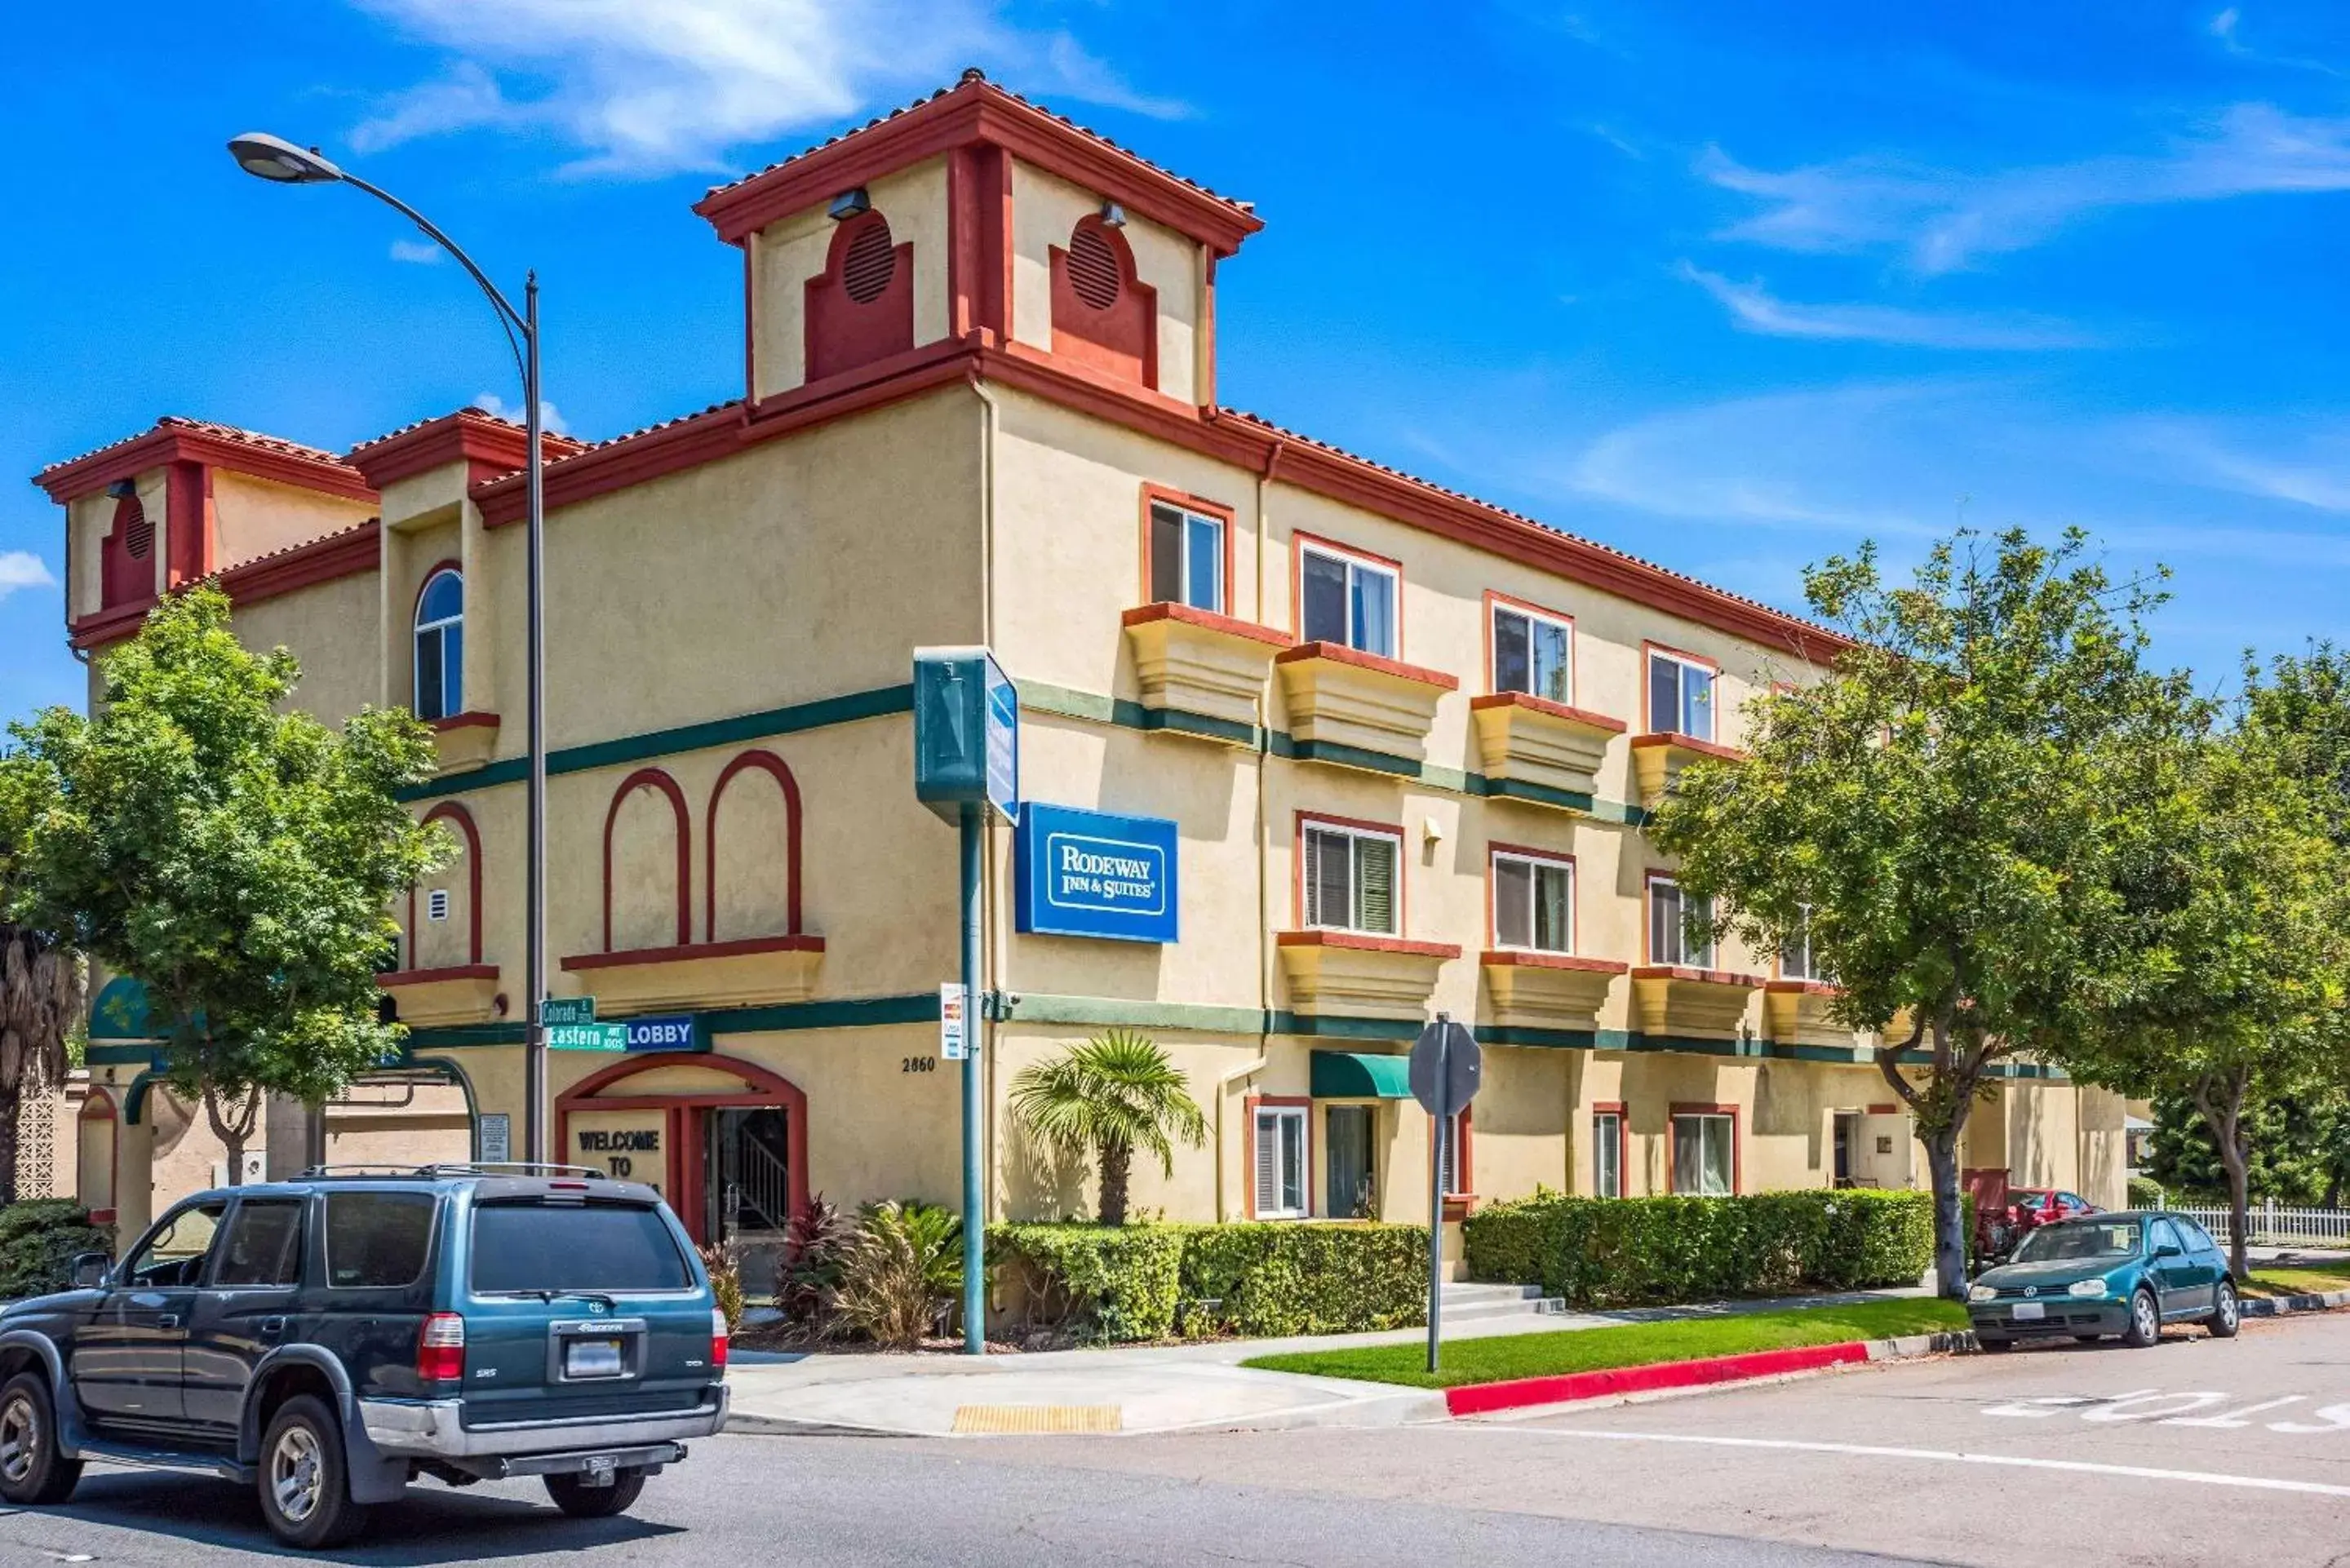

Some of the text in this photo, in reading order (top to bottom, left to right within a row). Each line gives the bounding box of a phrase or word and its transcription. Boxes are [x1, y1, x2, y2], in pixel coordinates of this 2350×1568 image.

[1062, 845, 1151, 879] RODEWAY
[1062, 875, 1089, 894] INN
[1091, 879, 1102, 893] &
[549, 1026, 601, 1045] Eastern
[627, 1024, 691, 1044] LOBBY
[902, 1056, 935, 1073] 2860
[579, 1130, 660, 1152] WELCOME
[608, 1156, 632, 1177] TO
